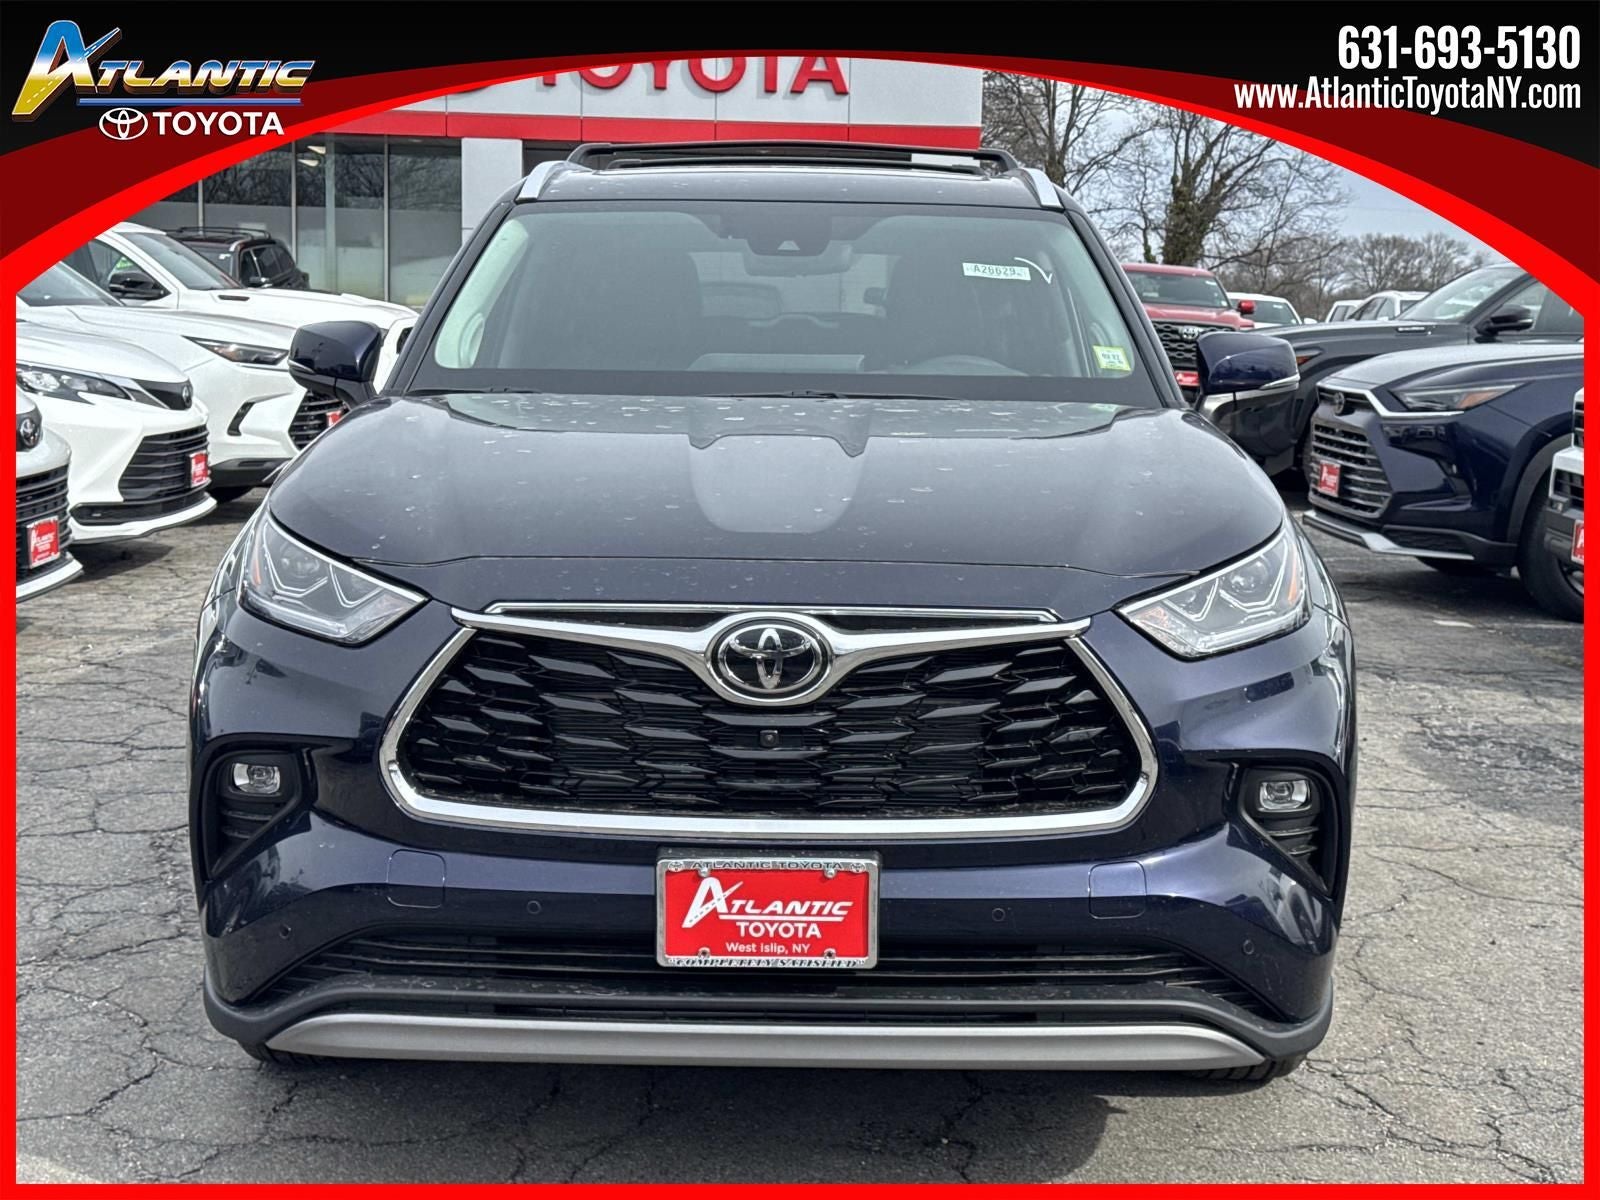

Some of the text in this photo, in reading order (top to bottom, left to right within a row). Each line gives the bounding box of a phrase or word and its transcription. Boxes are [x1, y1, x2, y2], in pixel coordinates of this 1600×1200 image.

[691, 861, 844, 870] ATLANTIC TOYOTA
[681, 876, 854, 929] ATLANTIC
[735, 921, 822, 939] TOYOTA
[725, 942, 811, 954] West Islip, NY
